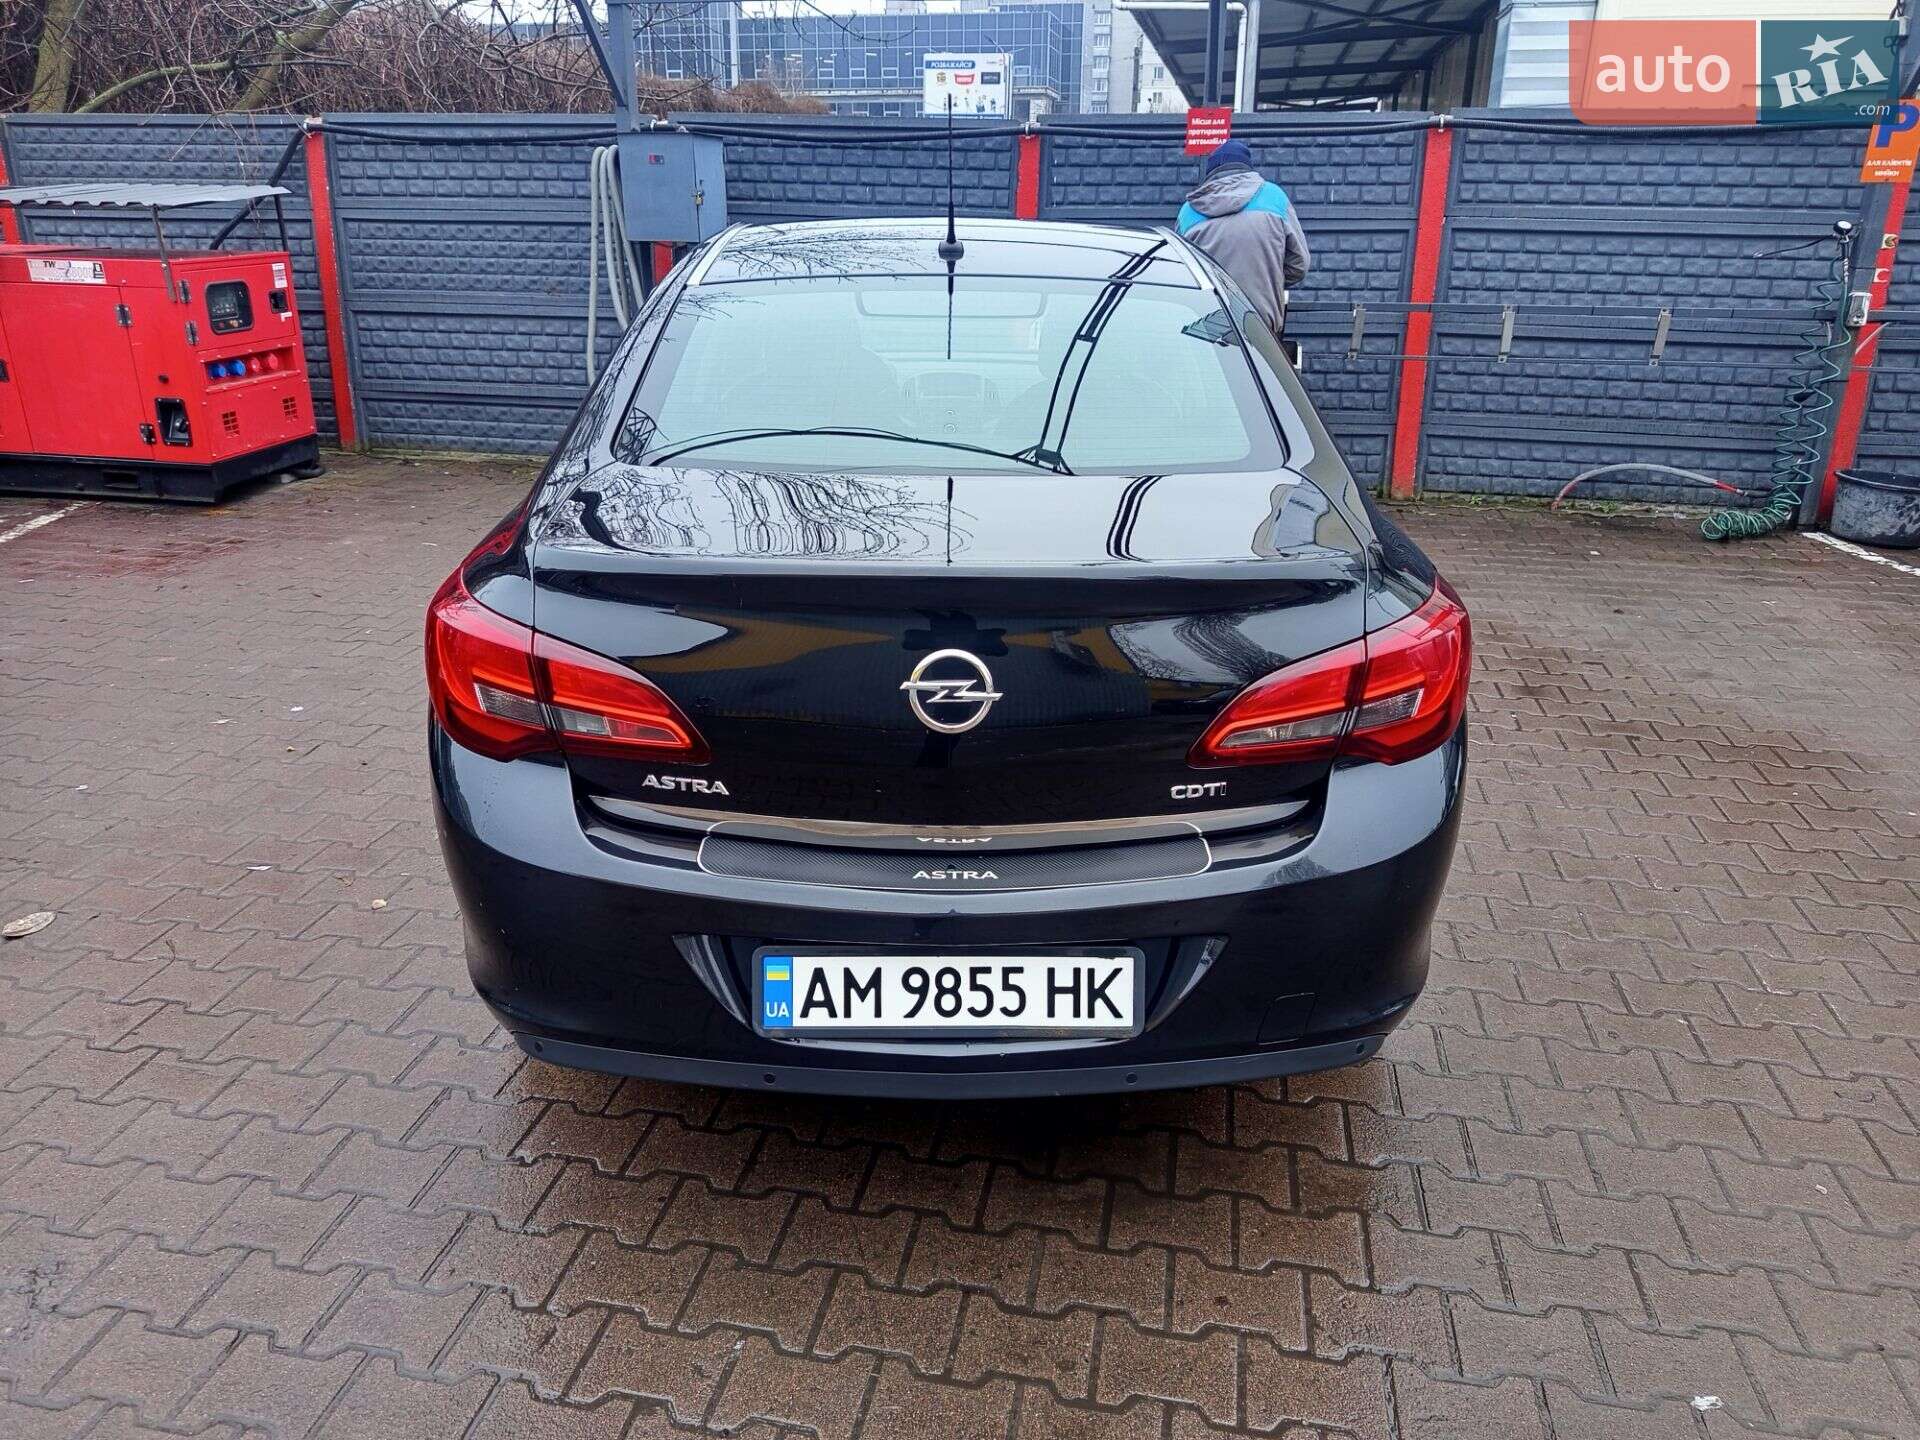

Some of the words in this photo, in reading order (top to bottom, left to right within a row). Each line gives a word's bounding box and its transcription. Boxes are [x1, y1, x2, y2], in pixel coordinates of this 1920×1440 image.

[641, 774, 730, 796] ASTRA
[912, 870, 999, 880] ASTRA
[799, 967, 883, 1018] AM
[901, 966, 1026, 1018] 9855
[1046, 967, 1124, 1018] HK
[766, 1001, 790, 1018] UA
